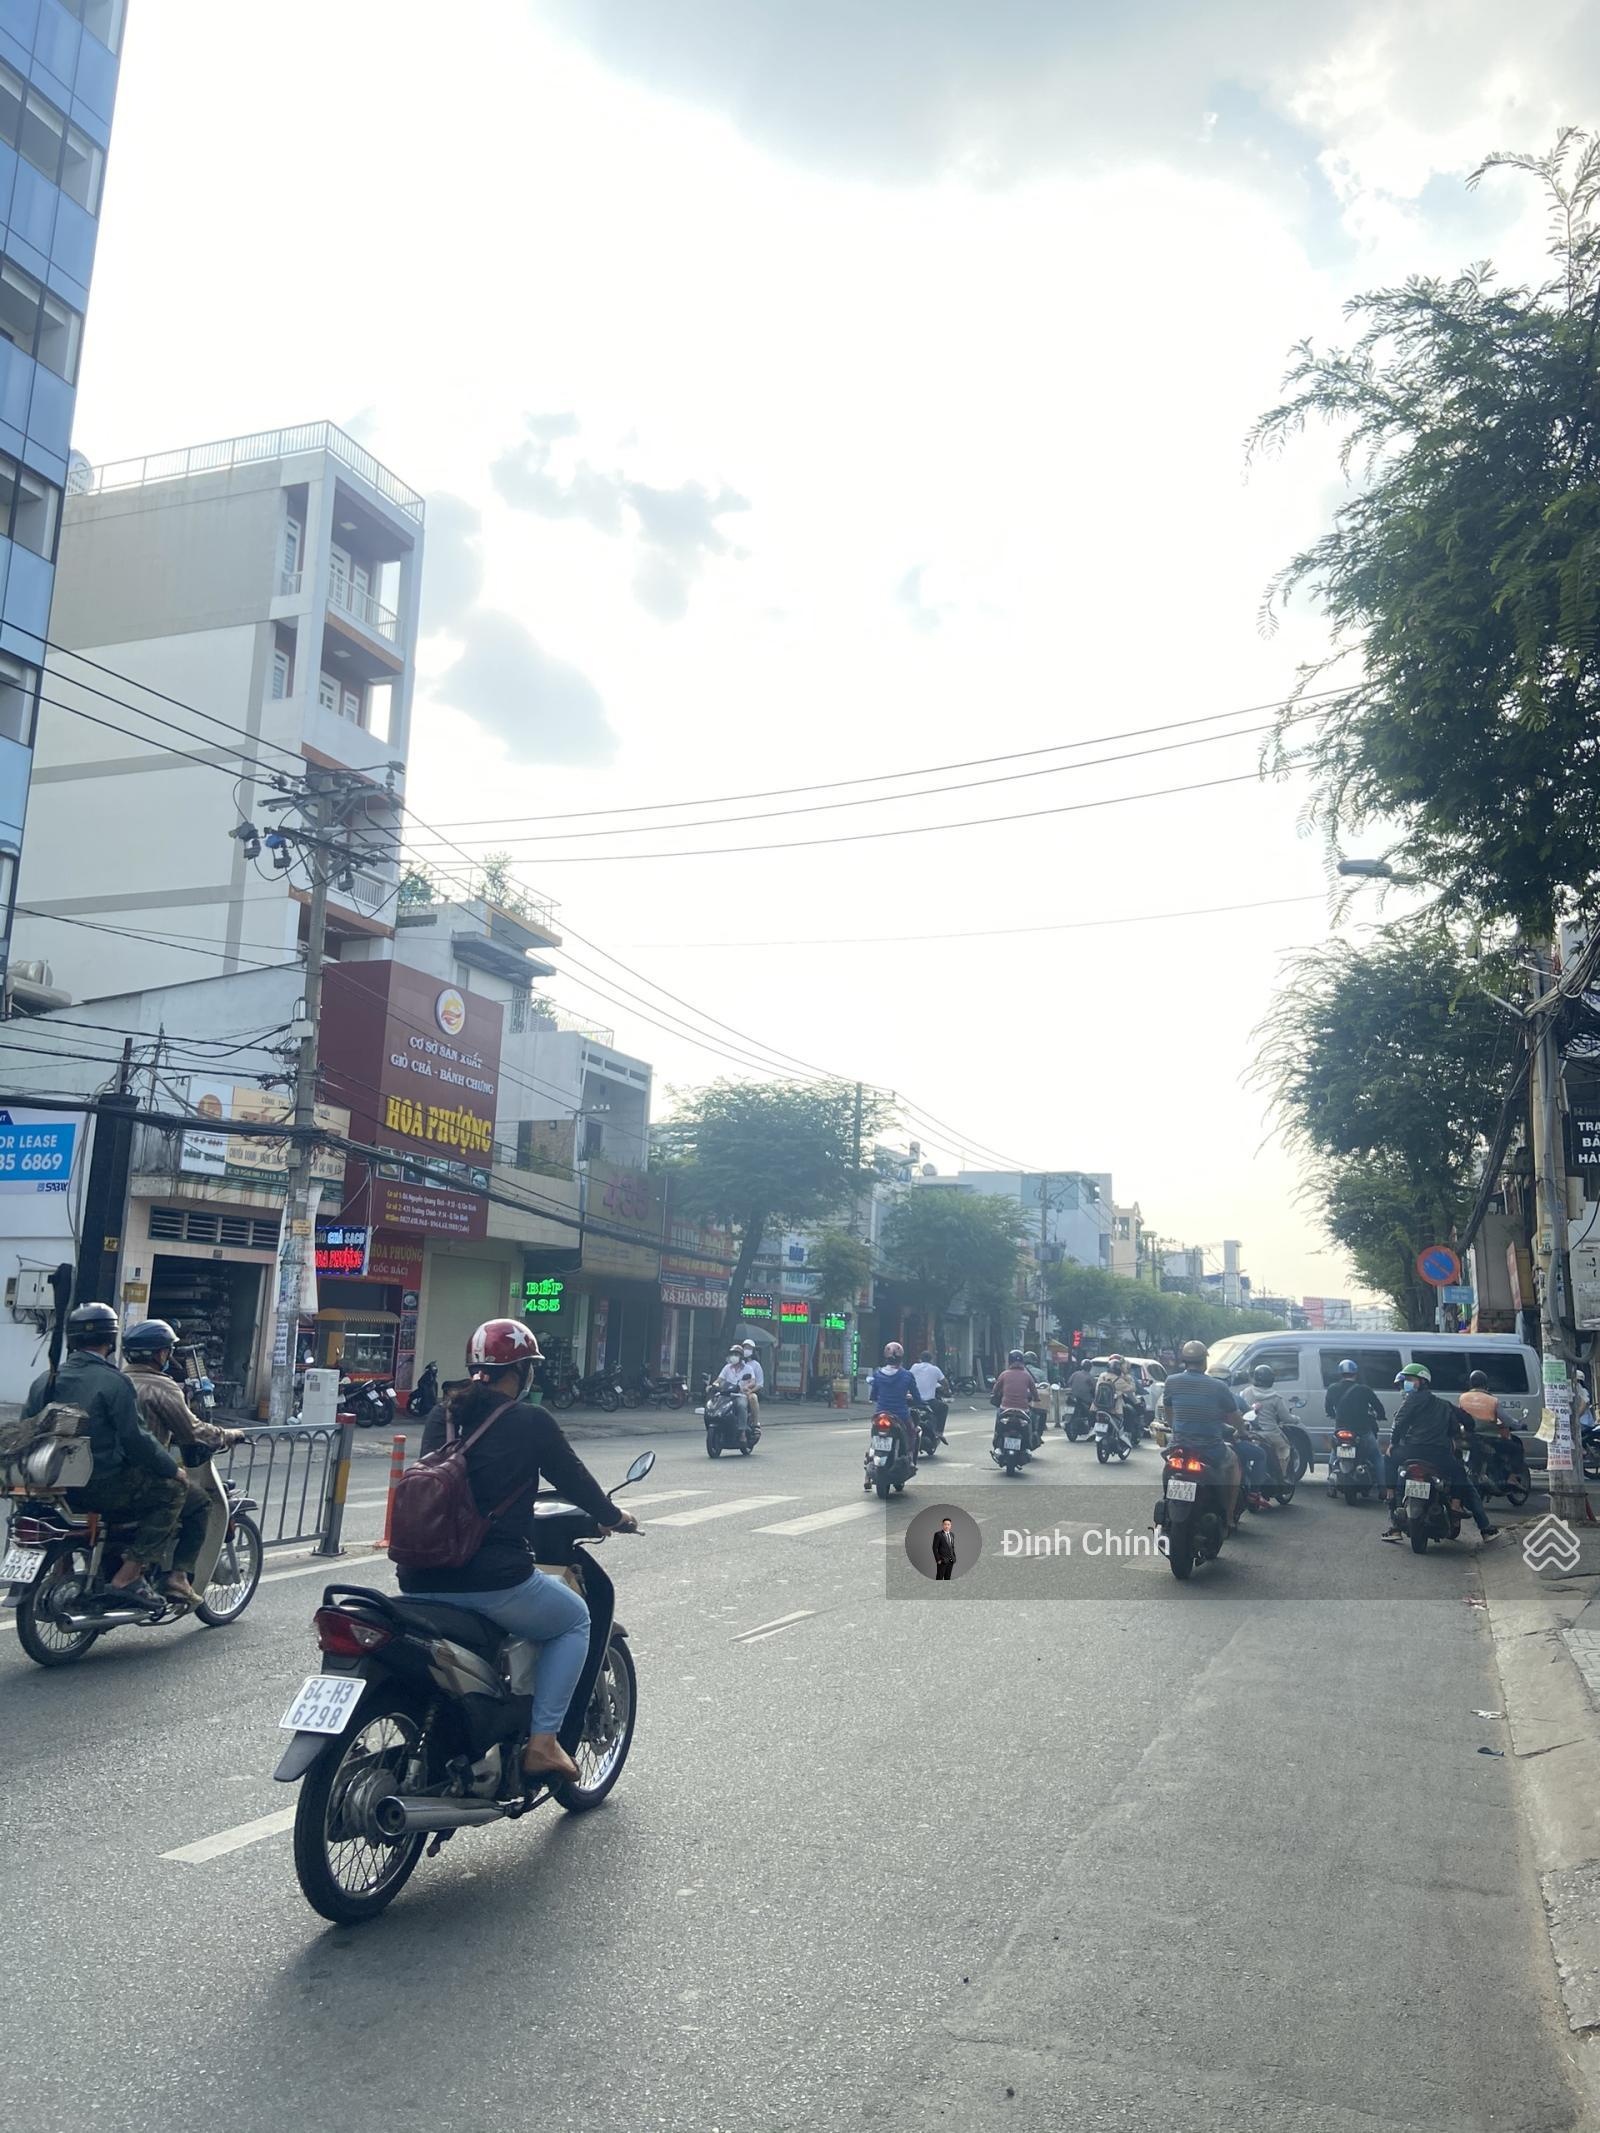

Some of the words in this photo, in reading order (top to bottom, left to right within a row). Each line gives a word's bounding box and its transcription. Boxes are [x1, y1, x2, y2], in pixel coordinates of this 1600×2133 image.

[390, 1052, 408, 1069] GIÒ
[411, 1060, 432, 1076] CHẢ
[439, 1067, 465, 1087] BÁNH
[465, 1077, 494, 1095] CHƯNG
[385, 1095, 423, 1138] HOA
[425, 1105, 492, 1154] PHƯỢNG
[19, 1134, 58, 1148] LEASE
[21, 1153, 63, 1171] 6869
[526, 1278, 563, 1295] BẾP
[304, 1680, 354, 1704] 64-H3
[292, 1703, 343, 1728] 6298
